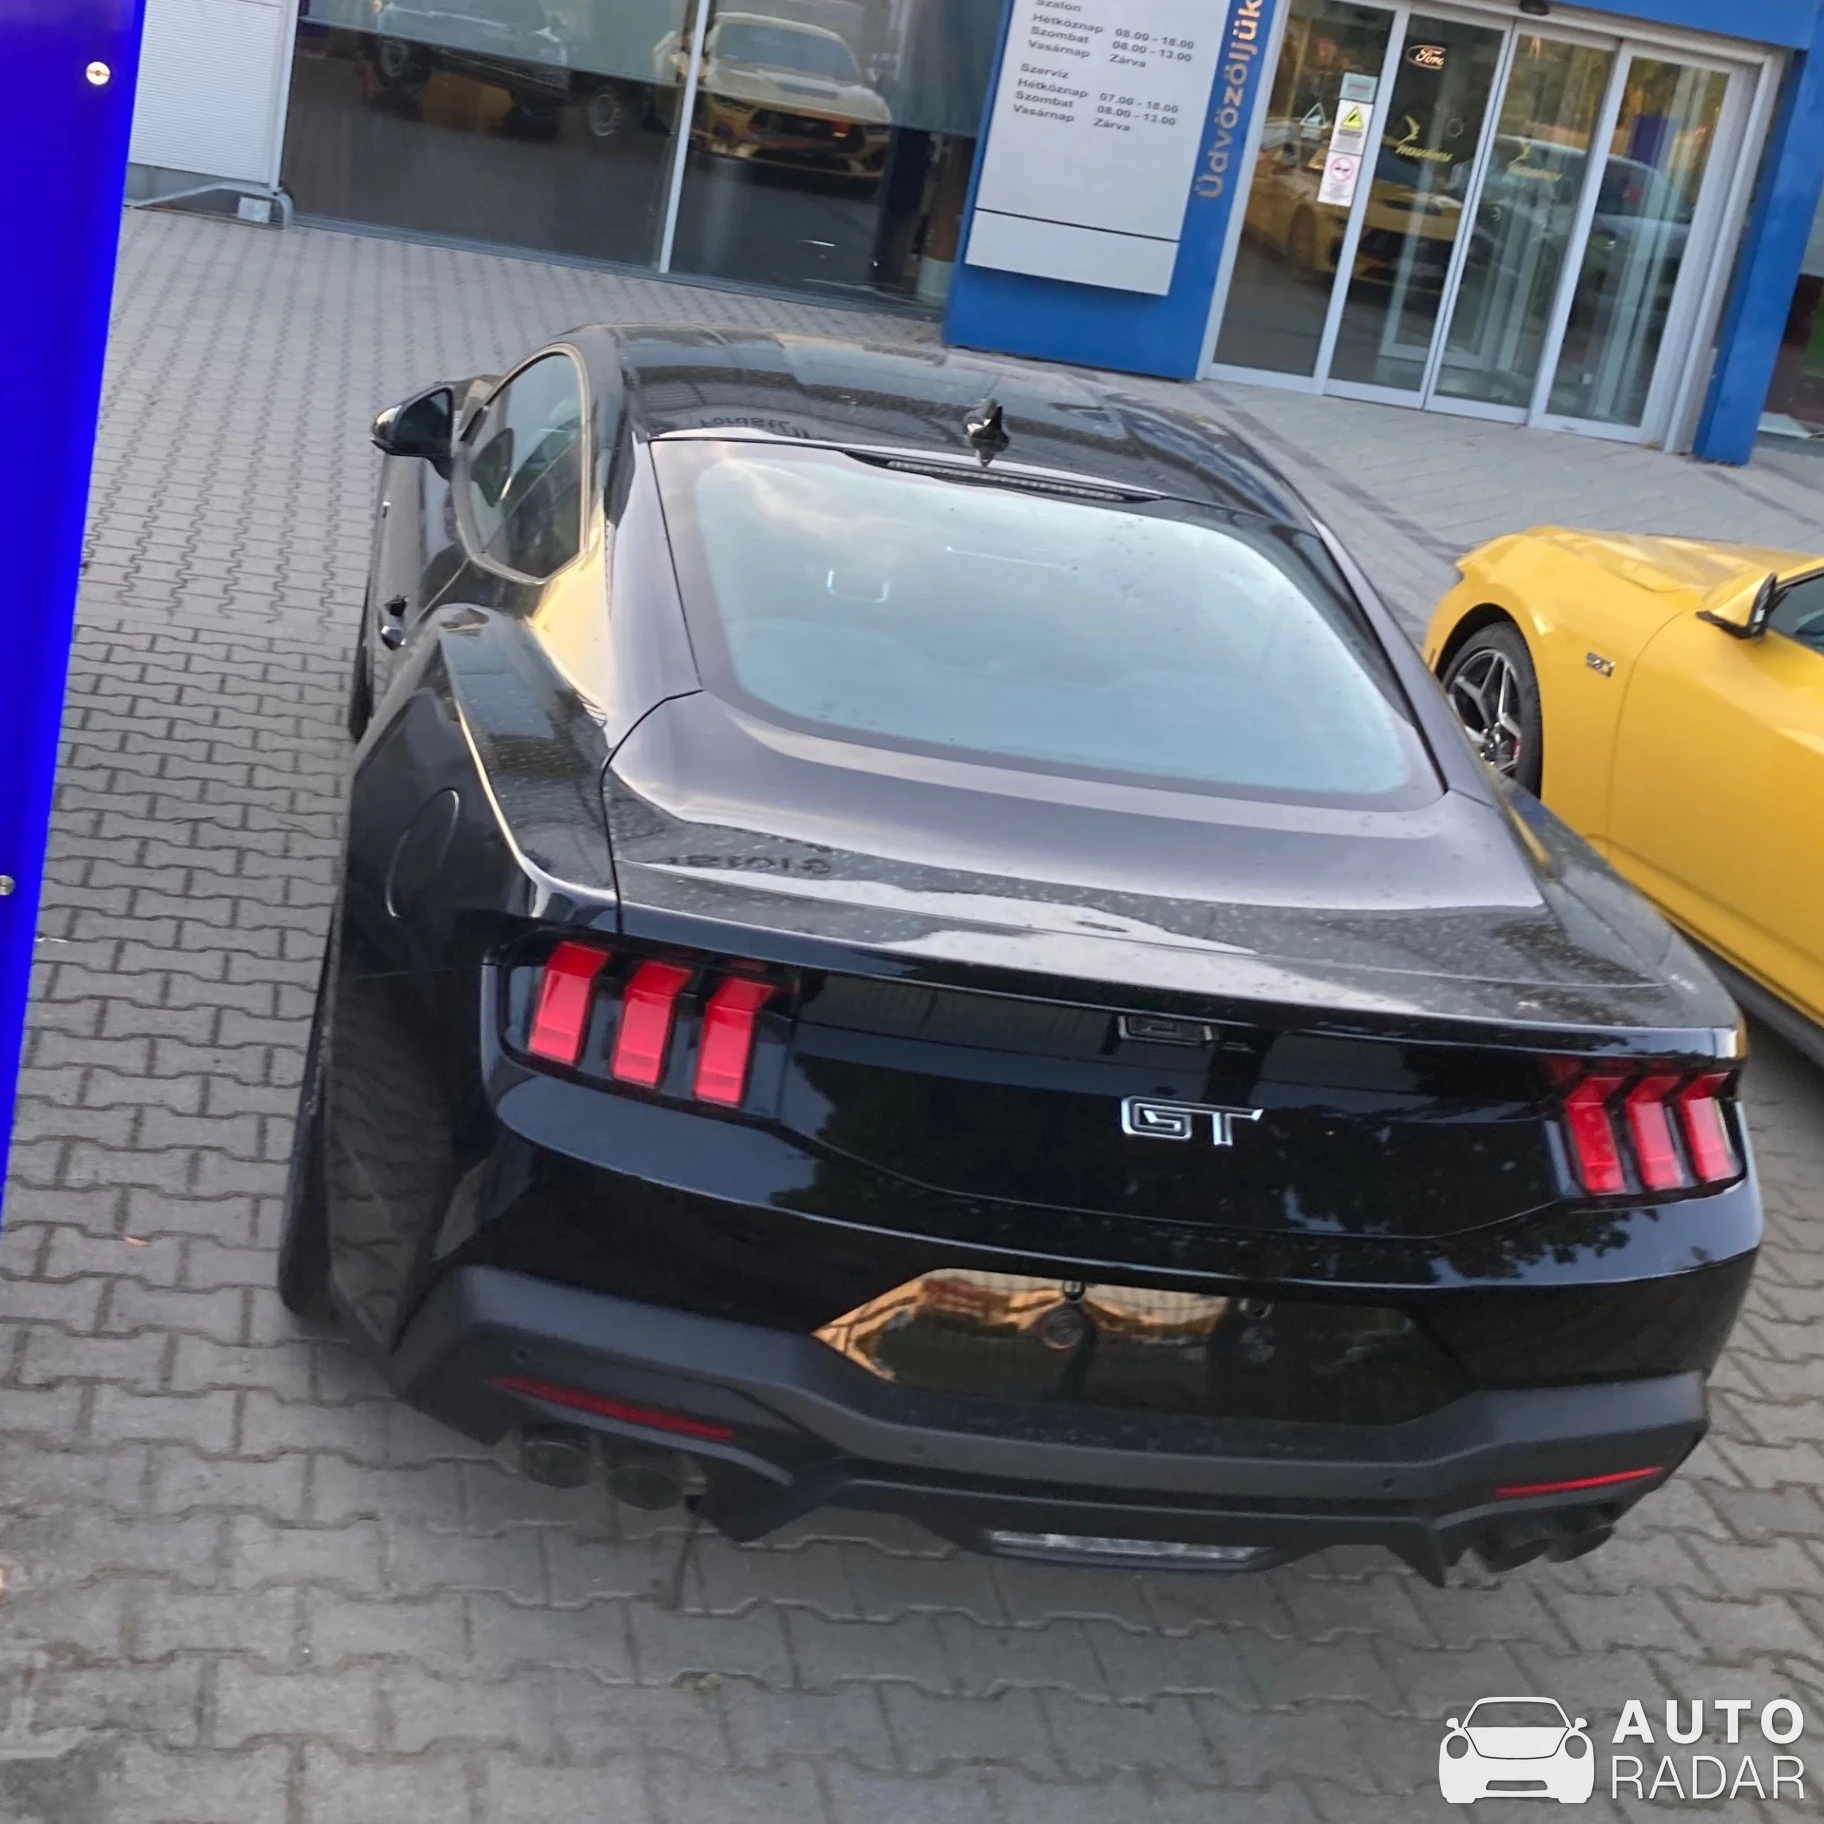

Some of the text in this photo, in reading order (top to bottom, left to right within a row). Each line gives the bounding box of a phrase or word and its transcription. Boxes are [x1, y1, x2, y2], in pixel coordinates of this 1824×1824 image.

[1030, 26, 1089, 43] Szombat
[1112, 41, 1147, 53] 08.00
[1160, 49, 1192, 62] 13.00
[1032, 13, 1103, 34] Hétköznap
[1115, 28, 1150, 41] 08.00
[1162, 36, 1195, 49] 18.00
[1028, 39, 1146, 67] Vasárnap Zárva
[1020, 63, 1070, 79] Szerviz
[1015, 90, 1074, 108] Szombat
[1097, 105, 1131, 117] 08.00
[1144, 113, 1176, 126] 13.00
[1017, 78, 1088, 98] Hétköznap
[1100, 92, 1134, 105] 07.00
[1147, 100, 1179, 113] 18.00
[1012, 104, 1130, 131] Vasárnap Zárva
[1121, 1095, 1263, 1146] GT
